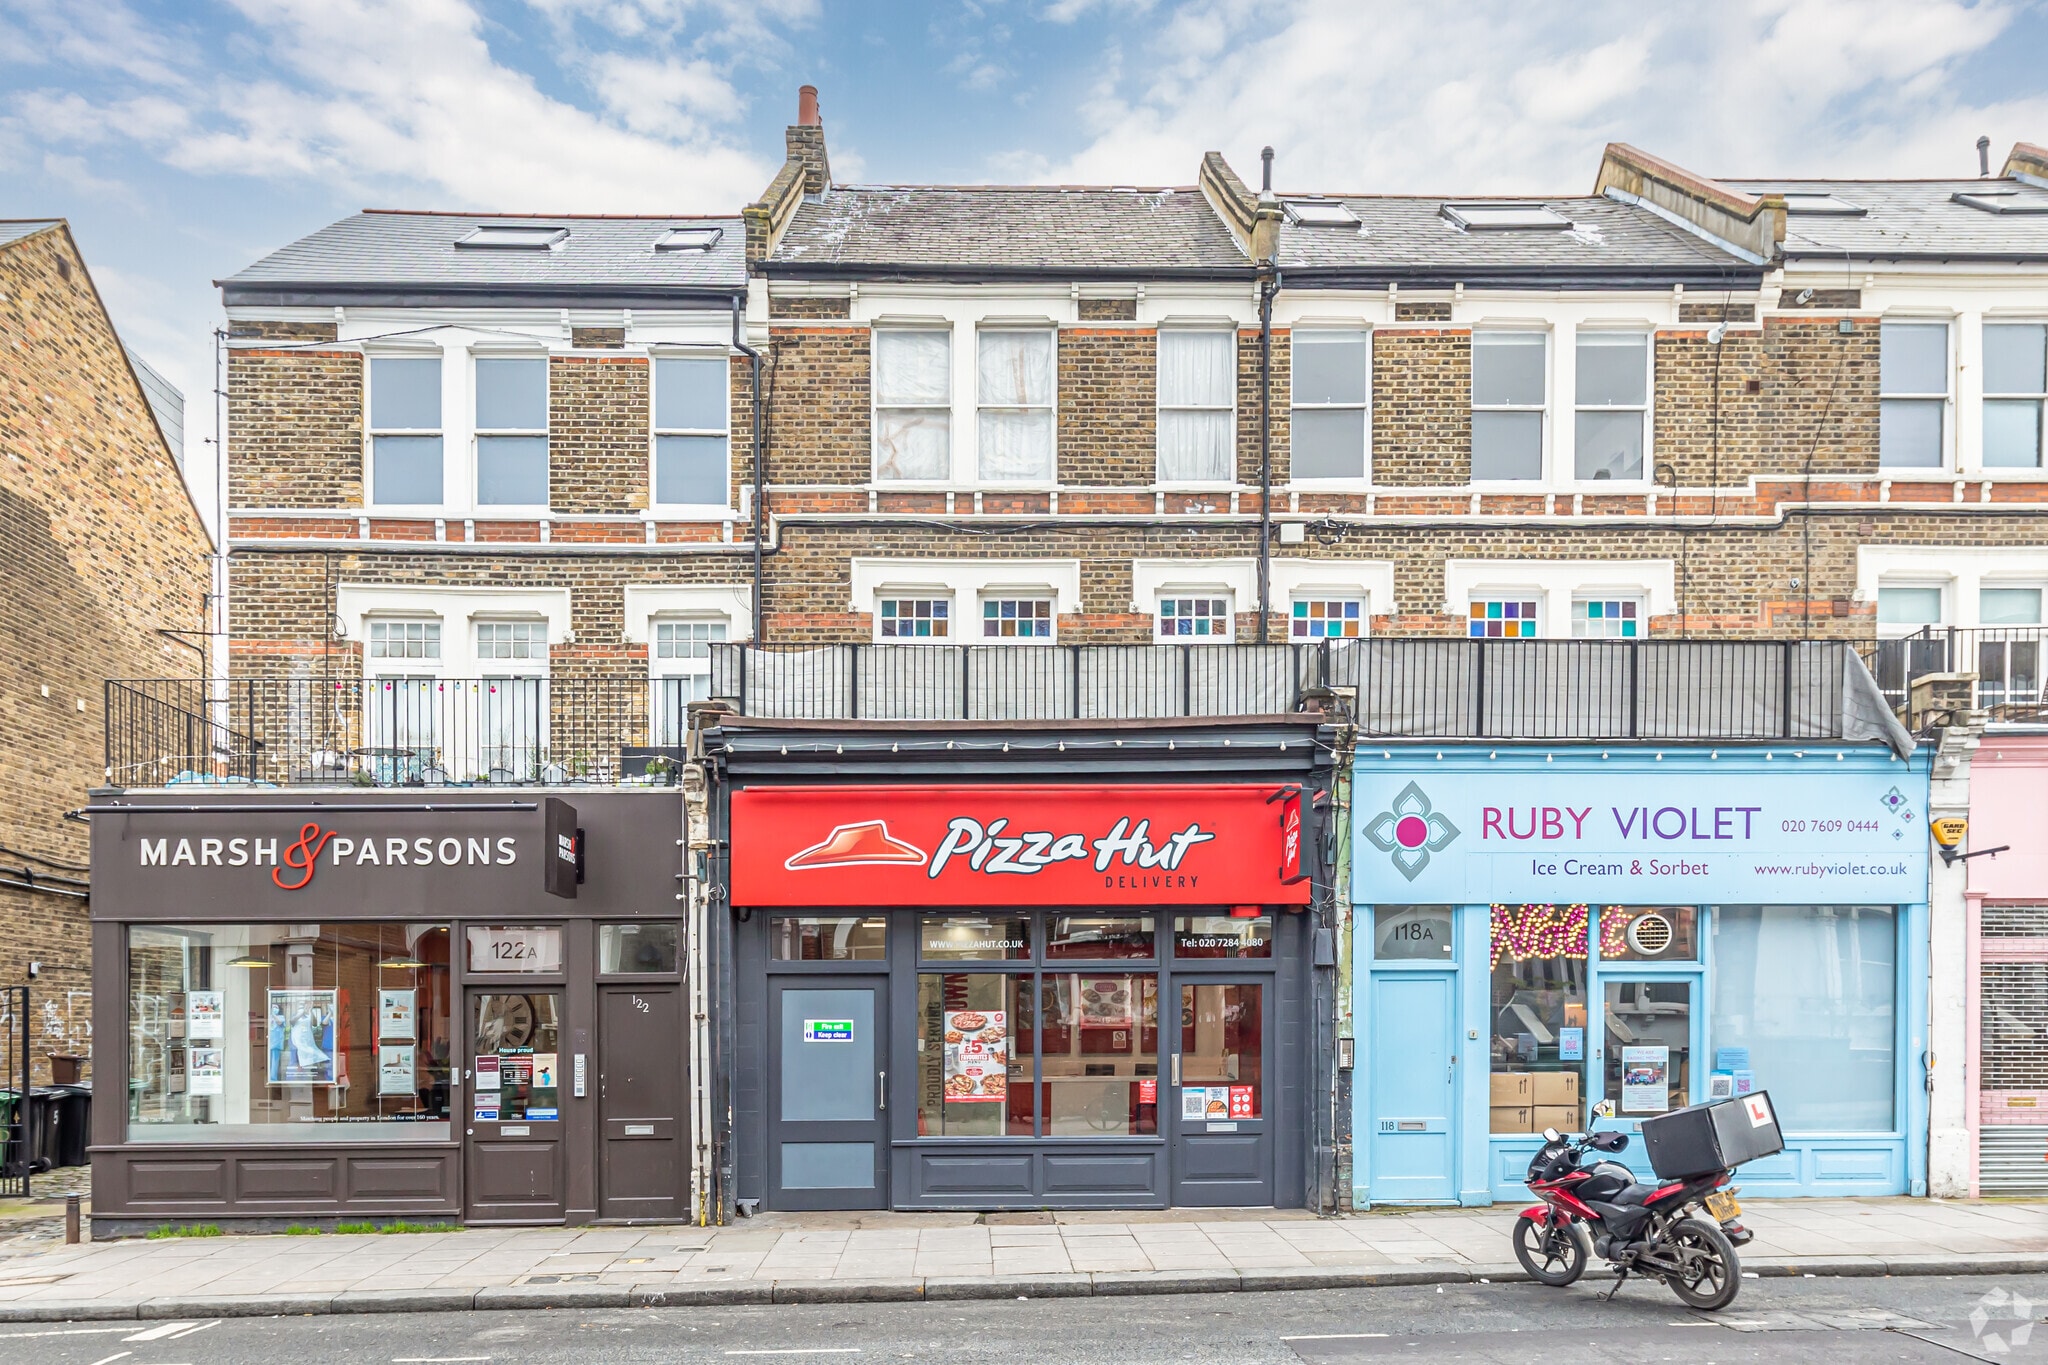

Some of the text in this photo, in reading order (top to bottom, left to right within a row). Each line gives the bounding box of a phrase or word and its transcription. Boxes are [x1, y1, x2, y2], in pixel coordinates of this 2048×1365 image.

[1482, 806, 1762, 840] RUBY VIOLET
[1781, 819, 1880, 833] 020 7609 0444
[558, 833, 572, 851] MARSH
[928, 816, 1216, 879] Pizza Hut
[139, 822, 518, 890] MARSH & PARSONS
[558, 845, 576, 865] PARSONS
[1531, 858, 1710, 876] Ice Cream & Sorbet
[1754, 861, 1908, 879] www.rubyviolet.co.uk
[1105, 876, 1199, 888] DELIVERY
[1394, 923, 1434, 941] 118A
[491, 941, 538, 960] 122A
[1181, 937, 1264, 948] Tel: 020 7284 4080
[632, 994, 650, 1013] 122
[817, 1031, 832, 1039] Keep
[927, 1001, 941, 1107] PROUDLY SERVING
[964, 1039, 983, 1054] £5
[53, 1109, 59, 1125] 5
[1751, 1103, 1766, 1121] L
[1381, 1121, 1395, 1131] 118
